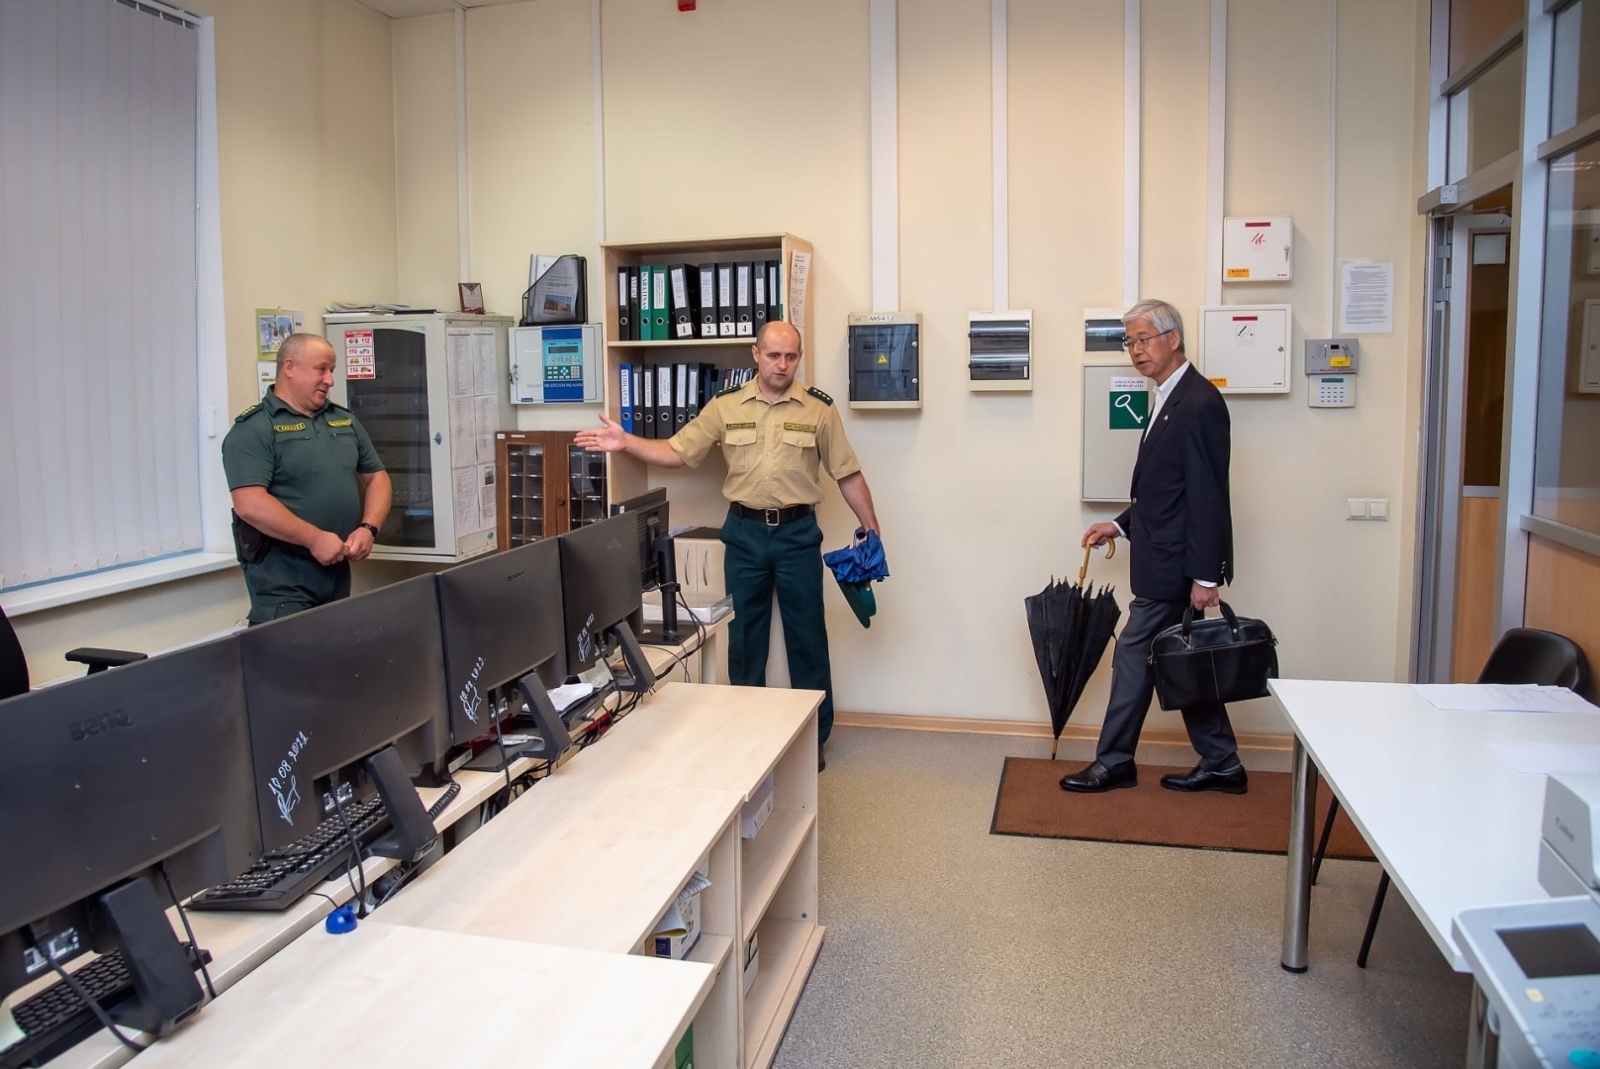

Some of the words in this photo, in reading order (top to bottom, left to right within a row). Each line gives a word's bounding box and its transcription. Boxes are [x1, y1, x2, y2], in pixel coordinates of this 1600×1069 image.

[706, 325, 712, 334] 2
[724, 325, 730, 333] 3
[741, 325, 748, 333] 4
